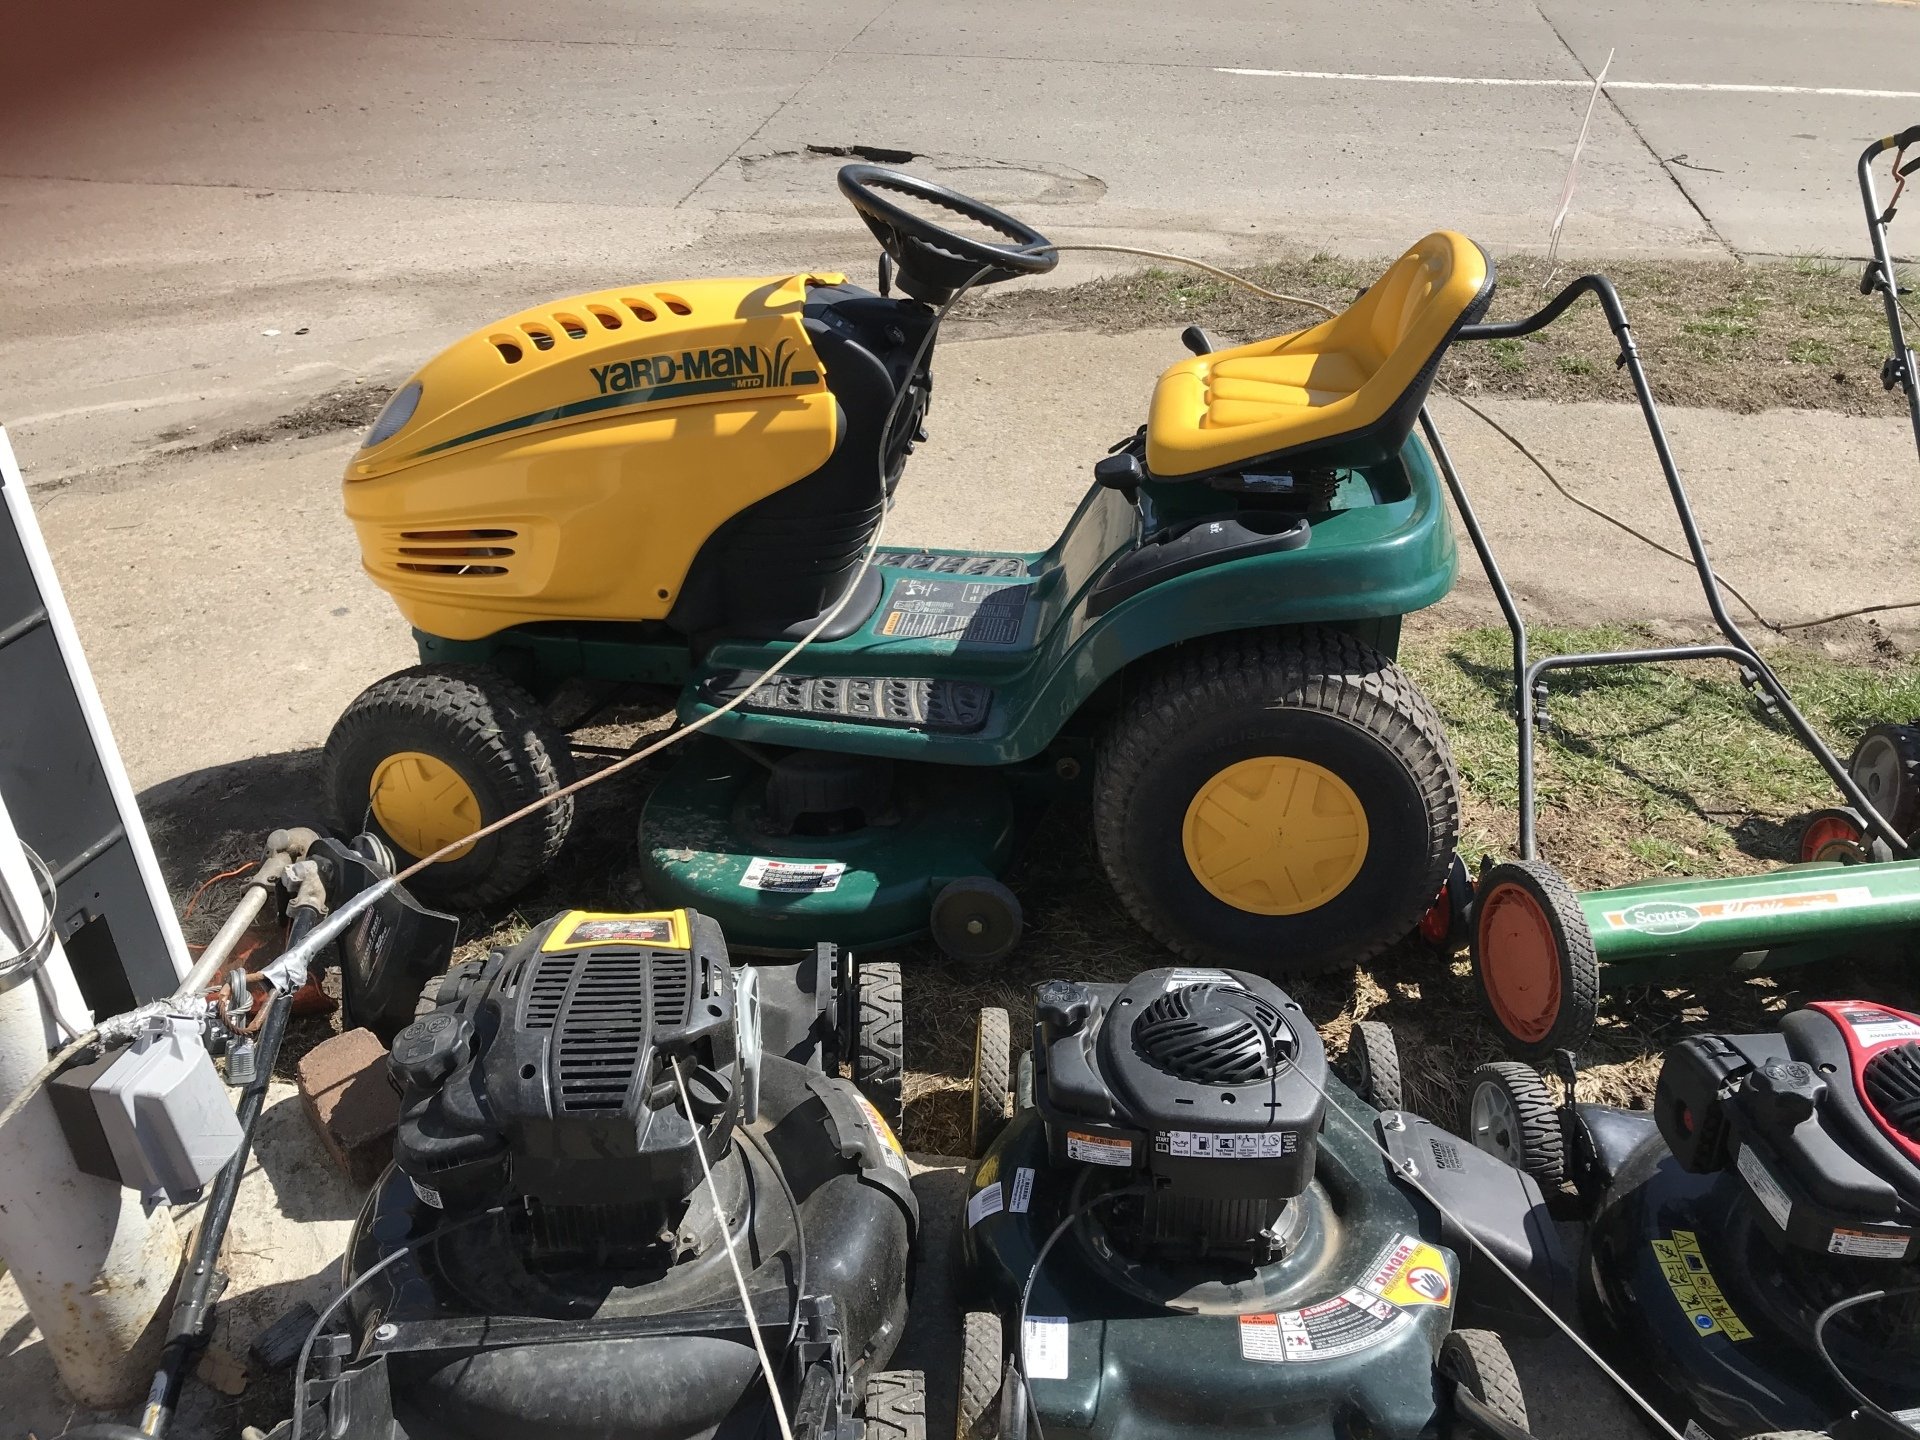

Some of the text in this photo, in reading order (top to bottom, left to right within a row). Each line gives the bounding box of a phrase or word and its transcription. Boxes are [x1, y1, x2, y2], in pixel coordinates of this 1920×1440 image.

[737, 378, 761, 388] MTD
[1634, 908, 1689, 924] Scotts
[860, 1101, 886, 1138] DANGER
[1430, 1138, 1445, 1169] CAUTION
[1374, 1245, 1413, 1287] DANGER
[1310, 1298, 1343, 1315] DANGER
